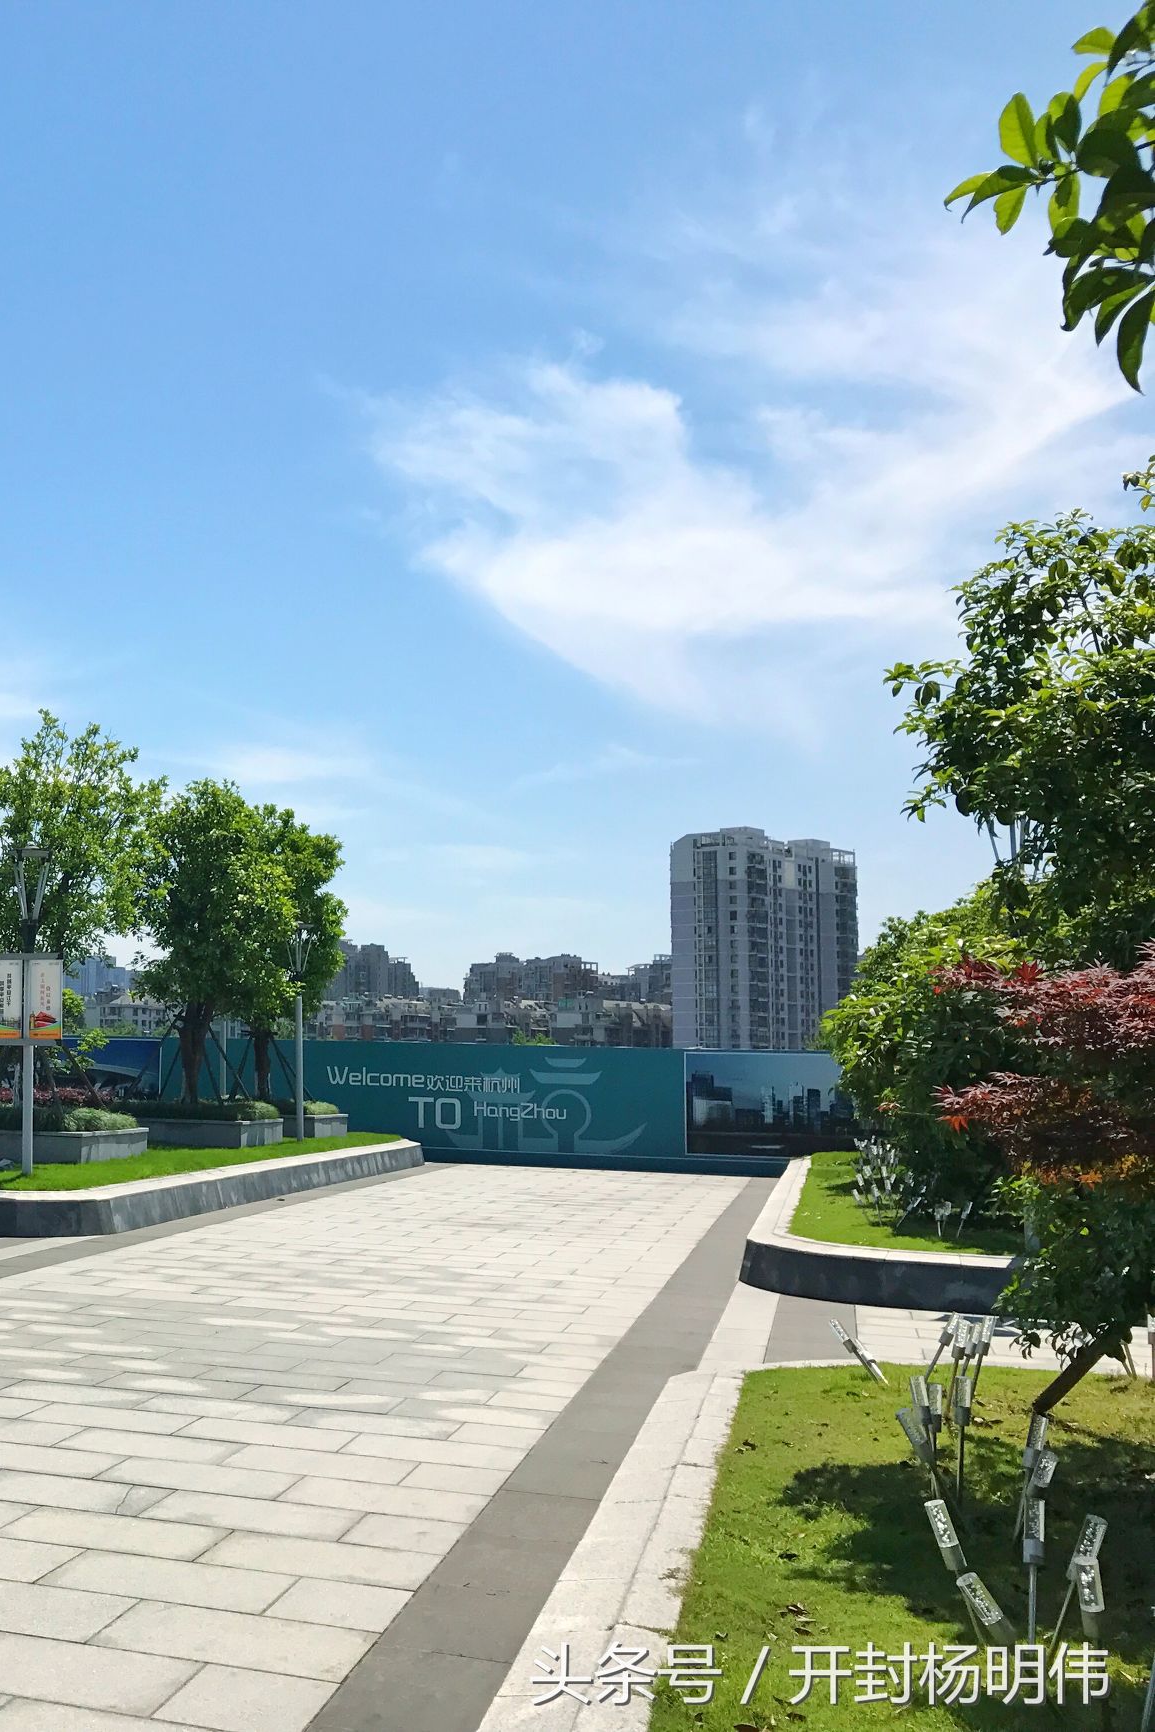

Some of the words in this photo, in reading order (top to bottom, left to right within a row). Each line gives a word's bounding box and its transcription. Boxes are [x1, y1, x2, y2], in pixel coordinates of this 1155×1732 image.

[326, 1066, 425, 1088] Welcome
[426, 1074, 520, 1095] 欢迎来杭州
[408, 1096, 462, 1130] TO
[473, 1100, 567, 1122] HangZhou
